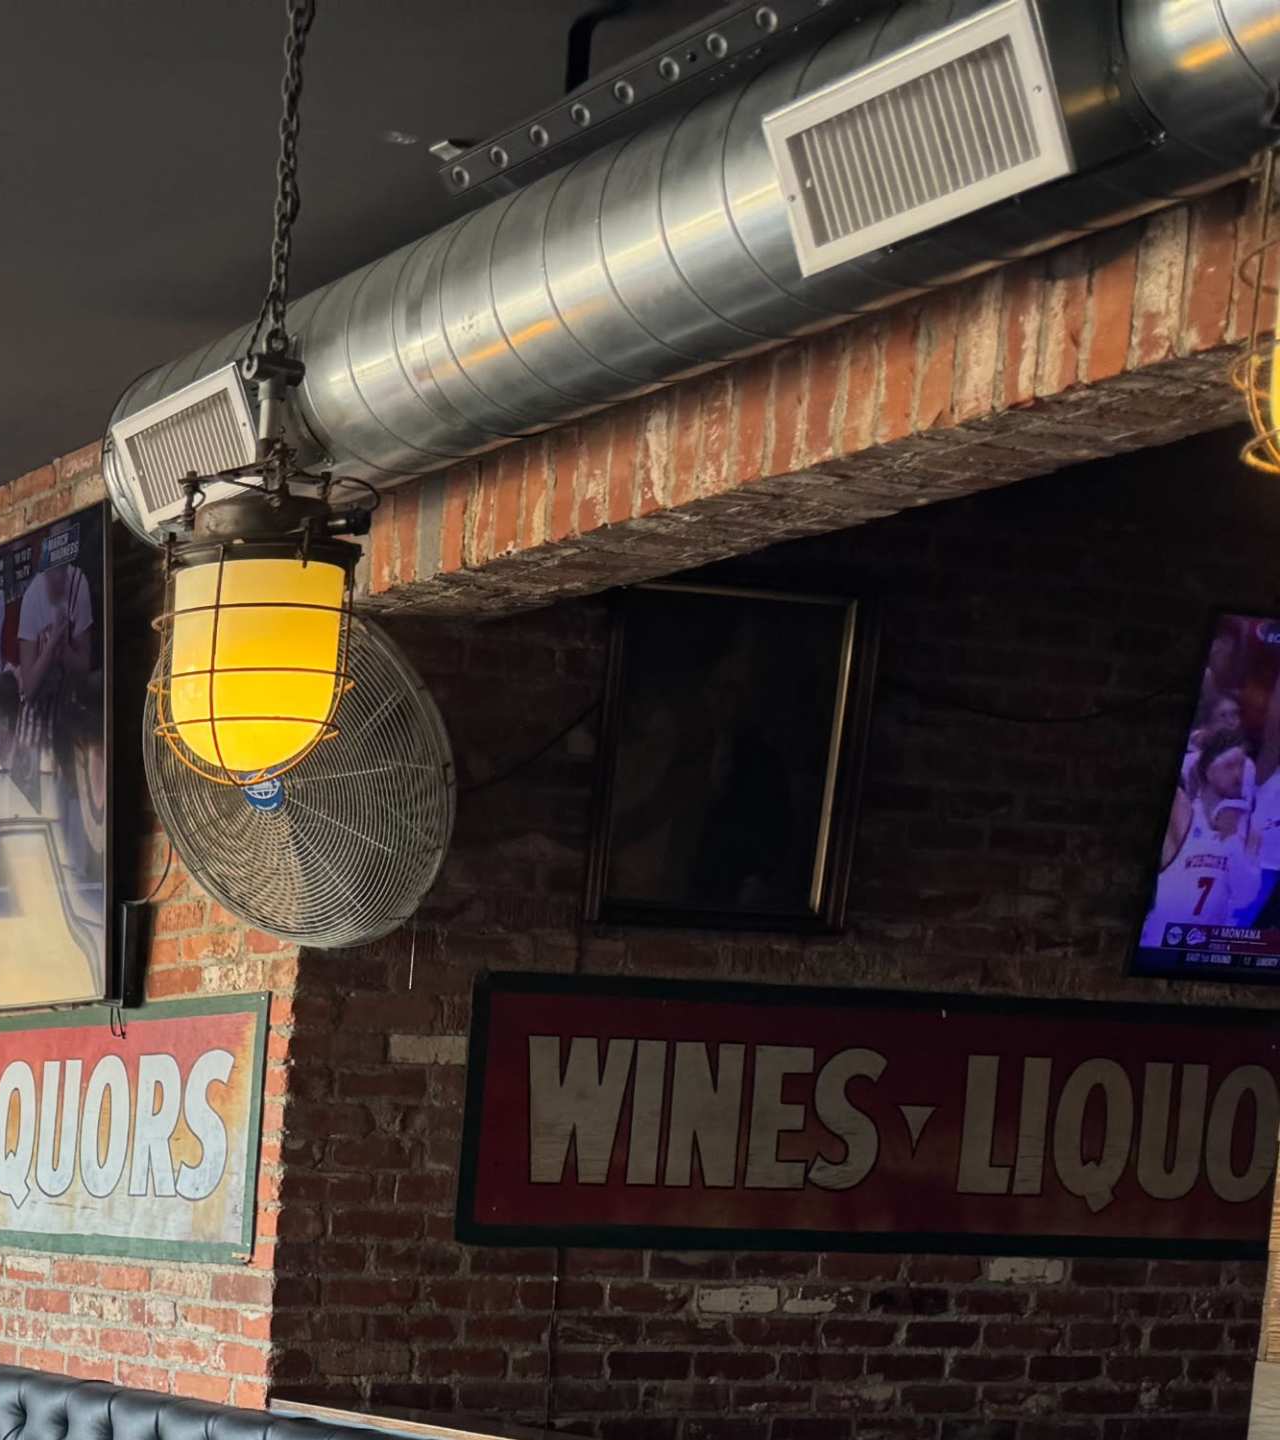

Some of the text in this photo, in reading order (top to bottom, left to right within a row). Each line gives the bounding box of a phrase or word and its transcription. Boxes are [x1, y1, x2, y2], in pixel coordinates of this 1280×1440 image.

[1192, 876, 1217, 917] 7
[526, 1033, 1278, 1216] WINES LIQUO
